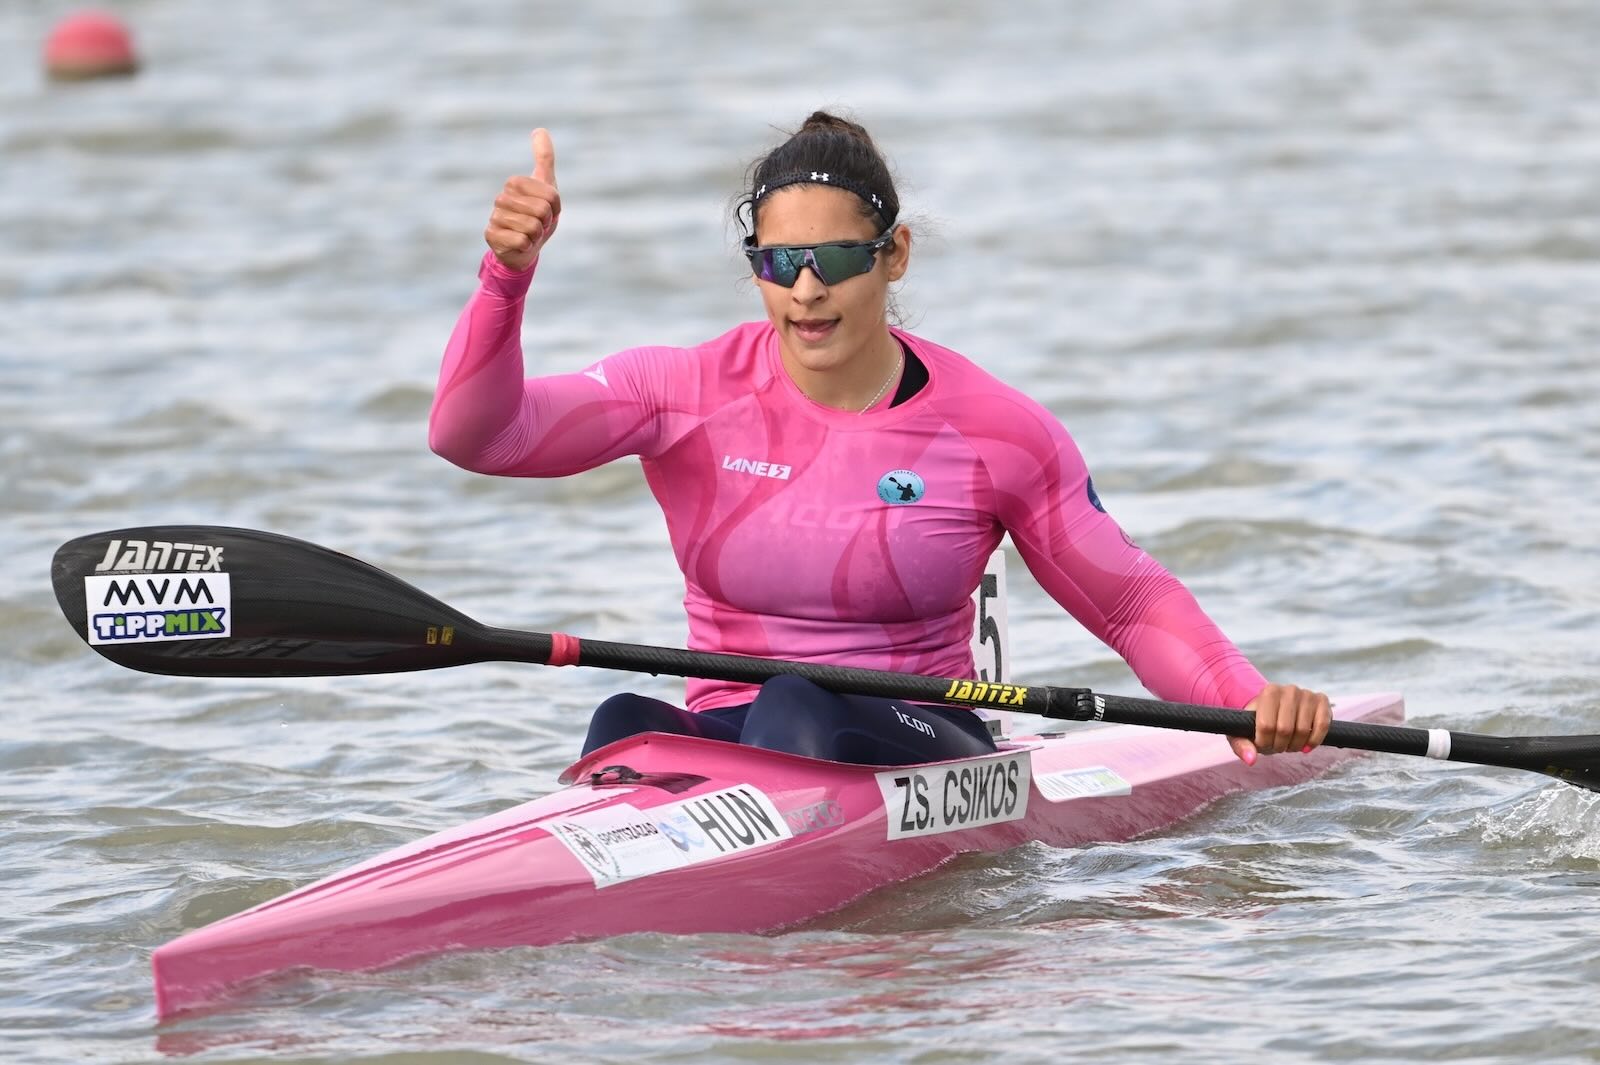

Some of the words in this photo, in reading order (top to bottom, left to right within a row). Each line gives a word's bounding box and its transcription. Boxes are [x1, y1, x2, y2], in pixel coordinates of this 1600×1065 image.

[95, 540, 224, 571] JANTEX
[103, 578, 214, 606] MVM
[945, 680, 1028, 705] JANTEX
[891, 706, 936, 738] icon
[894, 774, 935, 832] ZS.
[943, 759, 1019, 826] CSIKOS
[681, 789, 780, 852] HUN
